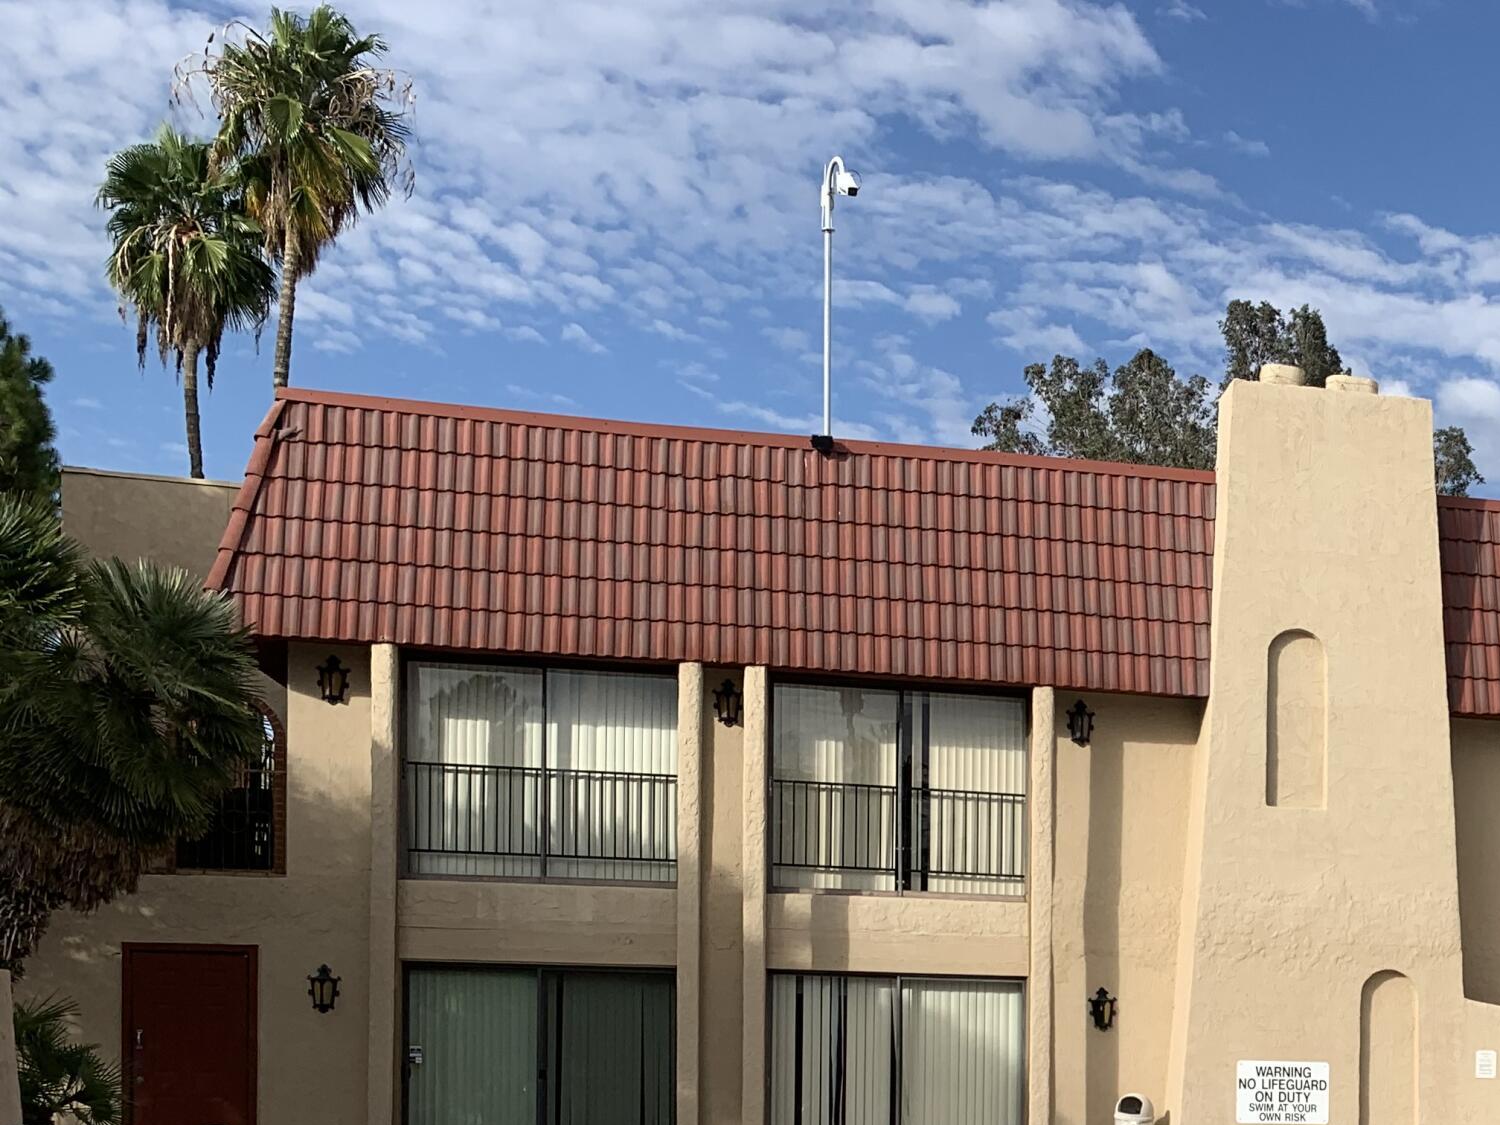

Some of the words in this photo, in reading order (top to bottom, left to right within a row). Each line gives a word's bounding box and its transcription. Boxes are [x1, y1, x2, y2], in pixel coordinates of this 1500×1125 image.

[1255, 1066, 1312, 1078] WARNING
[1238, 1078, 1256, 1090] NO
[1261, 1078, 1328, 1091] LIFEGUARD
[1255, 1091, 1273, 1102] ON
[1278, 1091, 1311, 1103] DUTY
[1248, 1103, 1274, 1112] SWIM
[1277, 1103, 1288, 1112] AT
[1292, 1104, 1317, 1113] YOUR
[1259, 1113, 1281, 1122] OWN
[1284, 1113, 1307, 1122] RISK
